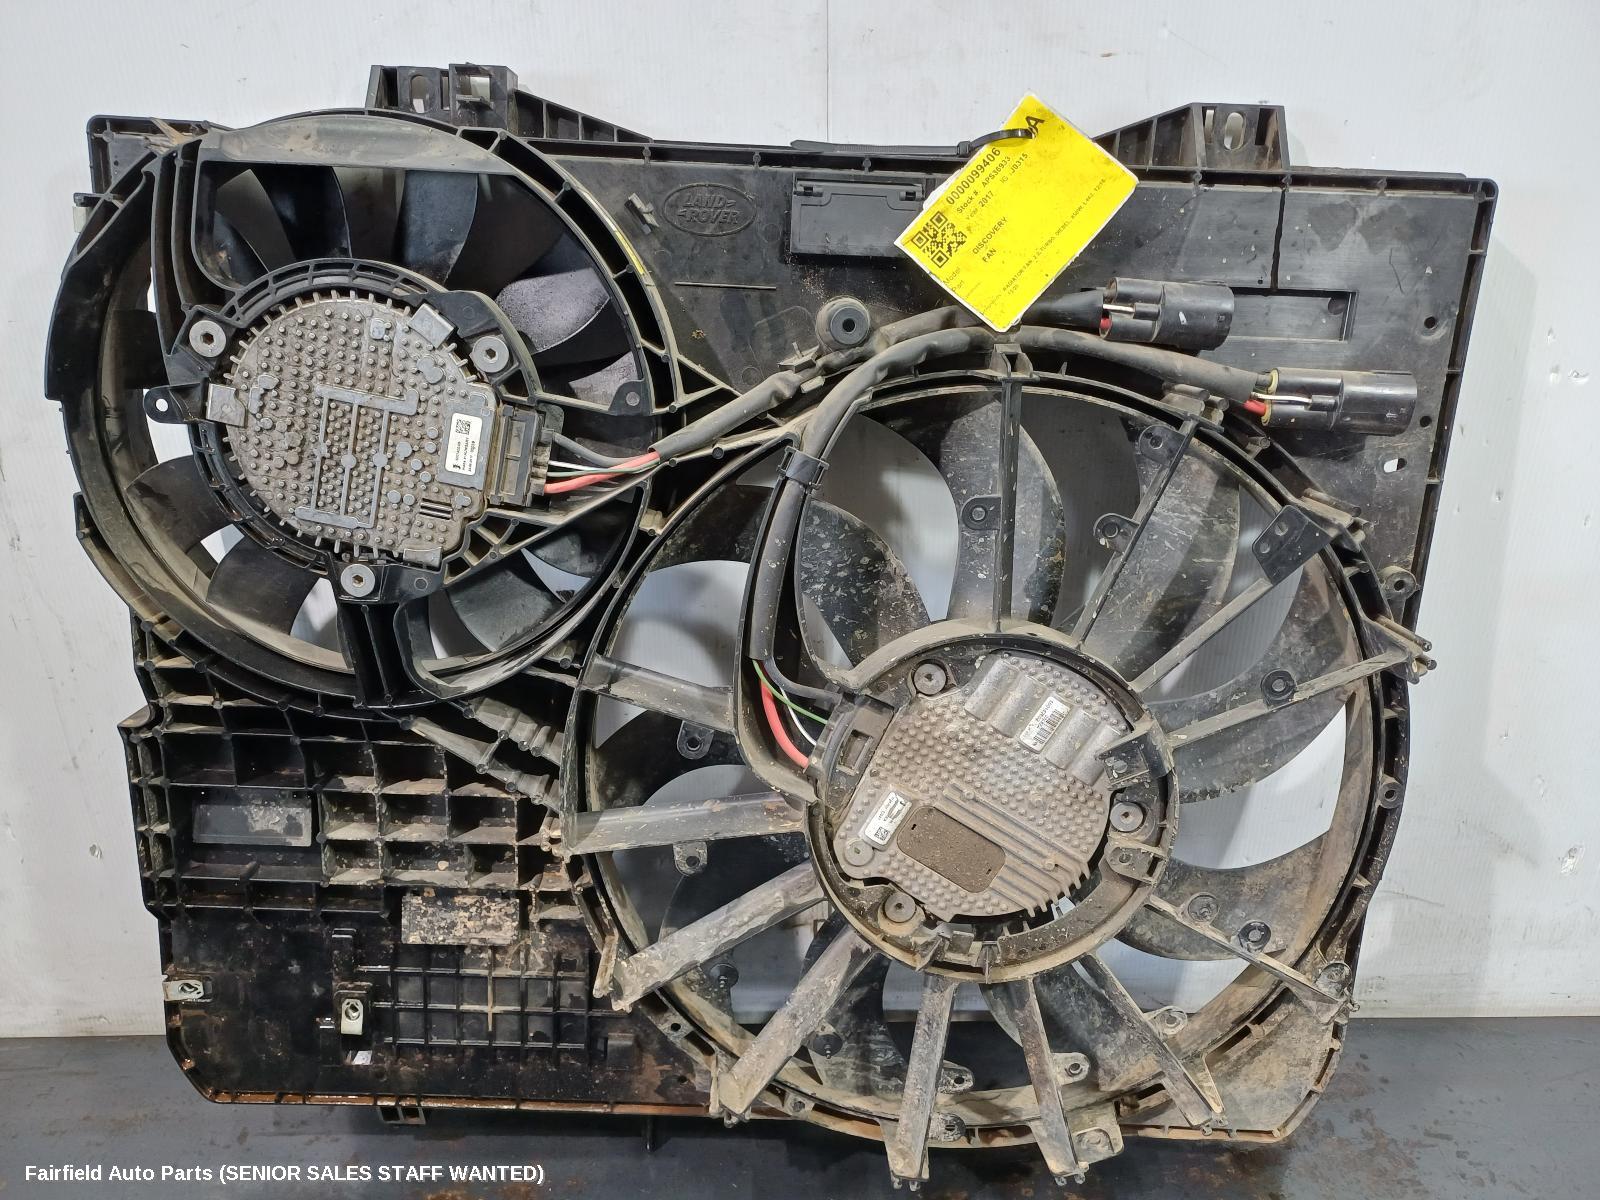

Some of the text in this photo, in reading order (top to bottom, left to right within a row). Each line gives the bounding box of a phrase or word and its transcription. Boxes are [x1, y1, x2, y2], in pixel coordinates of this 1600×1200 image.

[945, 146, 1002, 206] 0000099406
[683, 194, 727, 208] LAND
[956, 195, 975, 214] Stock
[978, 190, 995, 208] 2017
[686, 209, 740, 224] ROVER
[971, 215, 1008, 256] DISCOVERY
[981, 247, 997, 263] FAN
